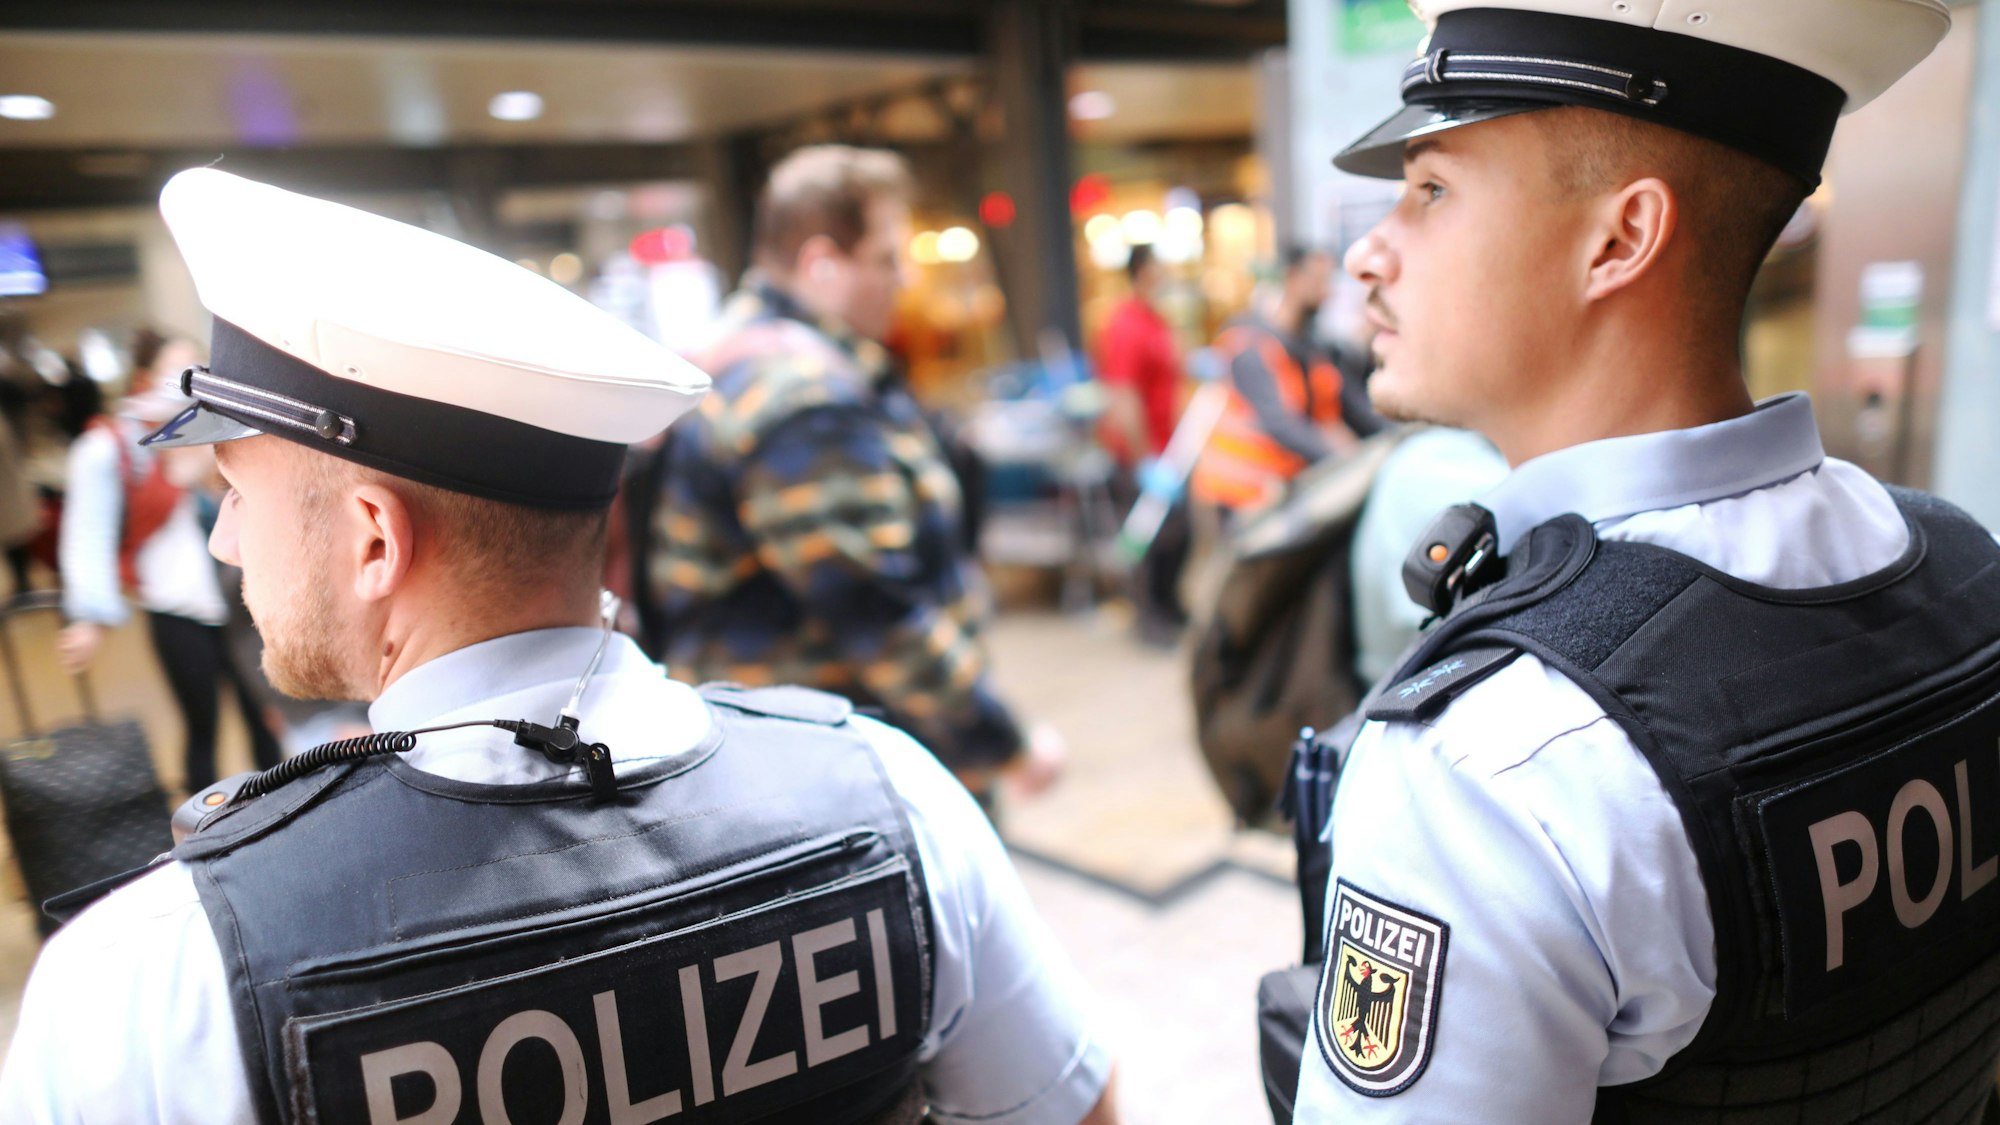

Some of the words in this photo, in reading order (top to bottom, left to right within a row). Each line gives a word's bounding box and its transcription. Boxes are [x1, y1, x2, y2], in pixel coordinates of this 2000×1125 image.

[1339, 900, 1426, 967] POLIZEI
[1808, 736, 2000, 972] POL
[360, 908, 897, 1125] POLIZEI
